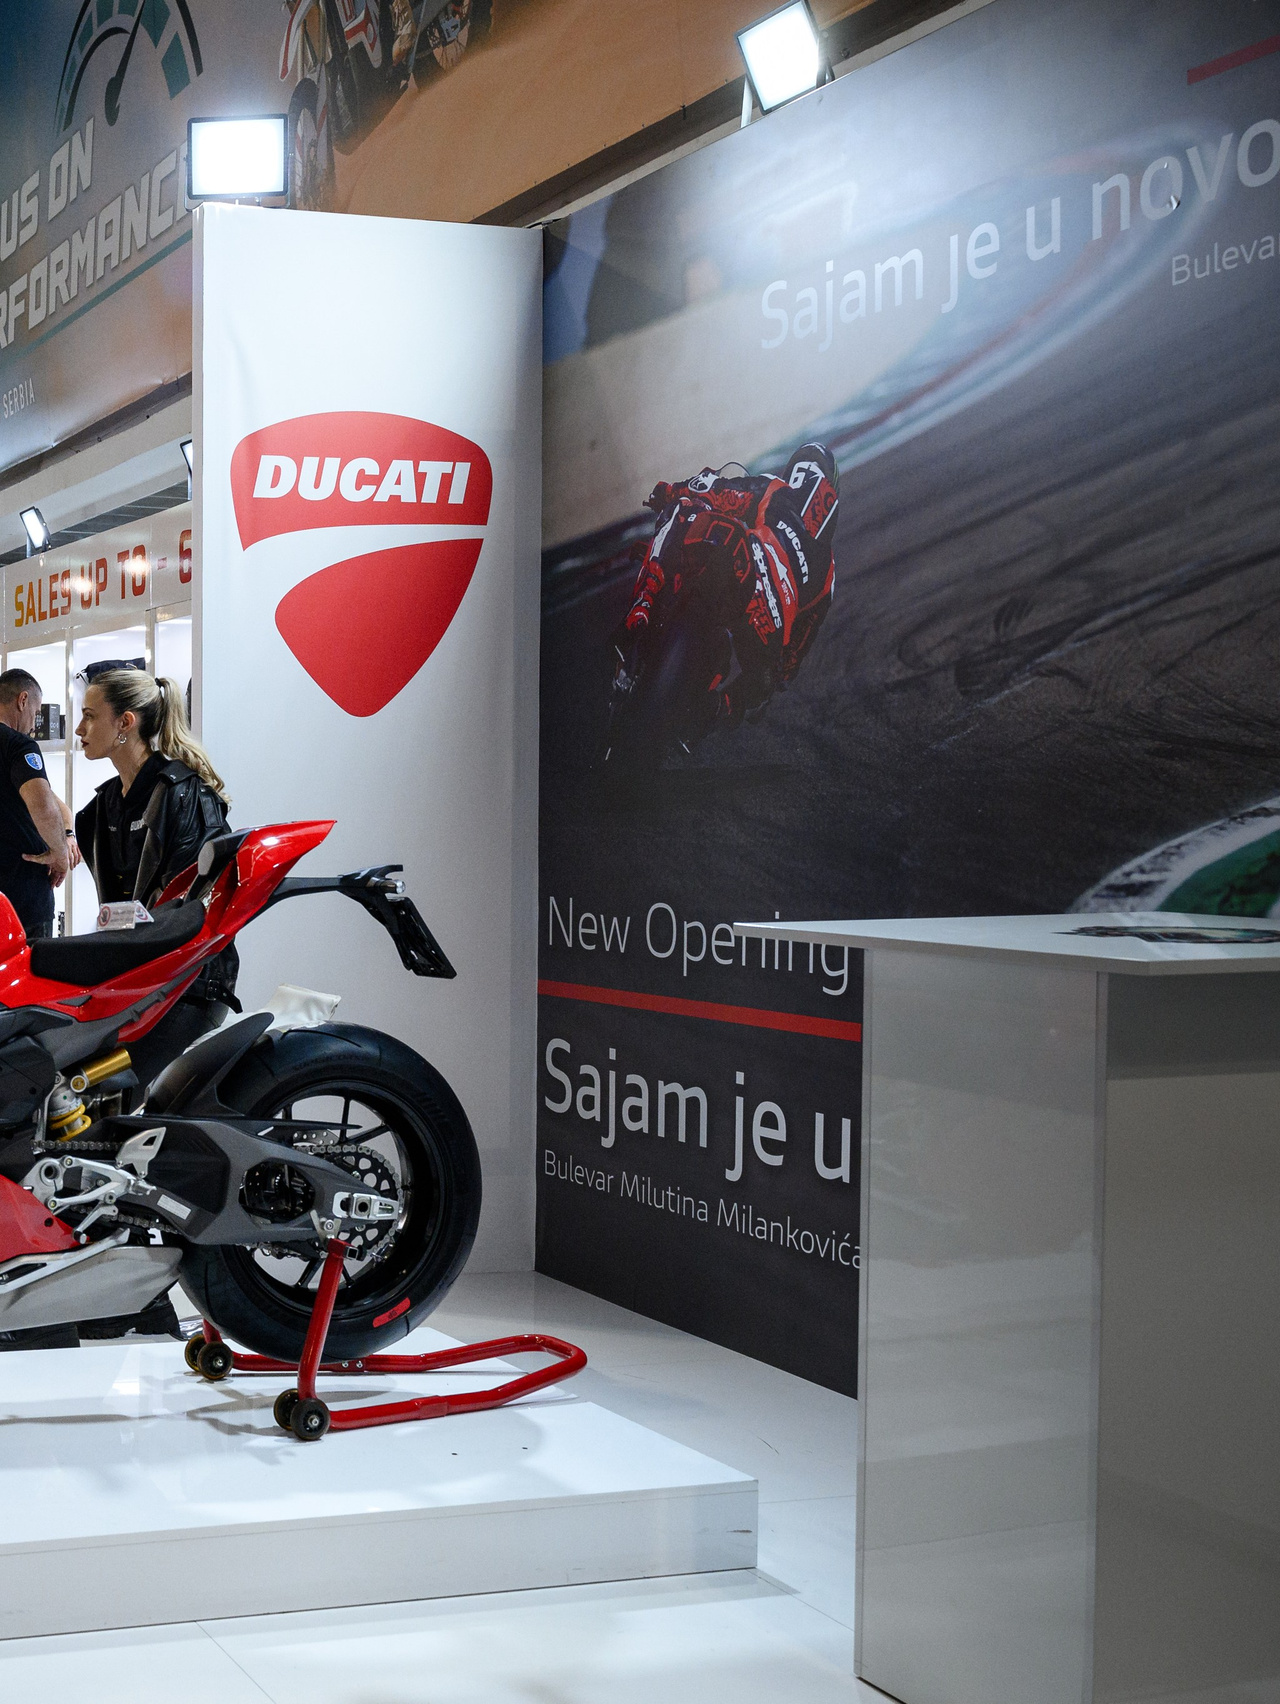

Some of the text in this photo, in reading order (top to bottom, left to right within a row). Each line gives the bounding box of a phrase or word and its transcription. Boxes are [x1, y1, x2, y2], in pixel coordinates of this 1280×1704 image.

[48, 117, 94, 222] ON
[761, 245, 924, 352] Sajam
[942, 220, 1000, 313] je
[1026, 197, 1061, 260] u
[1172, 233, 1280, 286] Buleva
[3, 378, 35, 417] SERBIA
[253, 455, 471, 504] DUCATI
[14, 569, 70, 627] SALES
[80, 557, 107, 610] UP
[117, 544, 146, 600] TO
[776, 521, 809, 585] DUCATI
[549, 896, 631, 953] New
[545, 1038, 851, 1184] Sajam je u
[545, 1150, 614, 1193] Bulevar
[620, 1171, 709, 1223] Milutina
